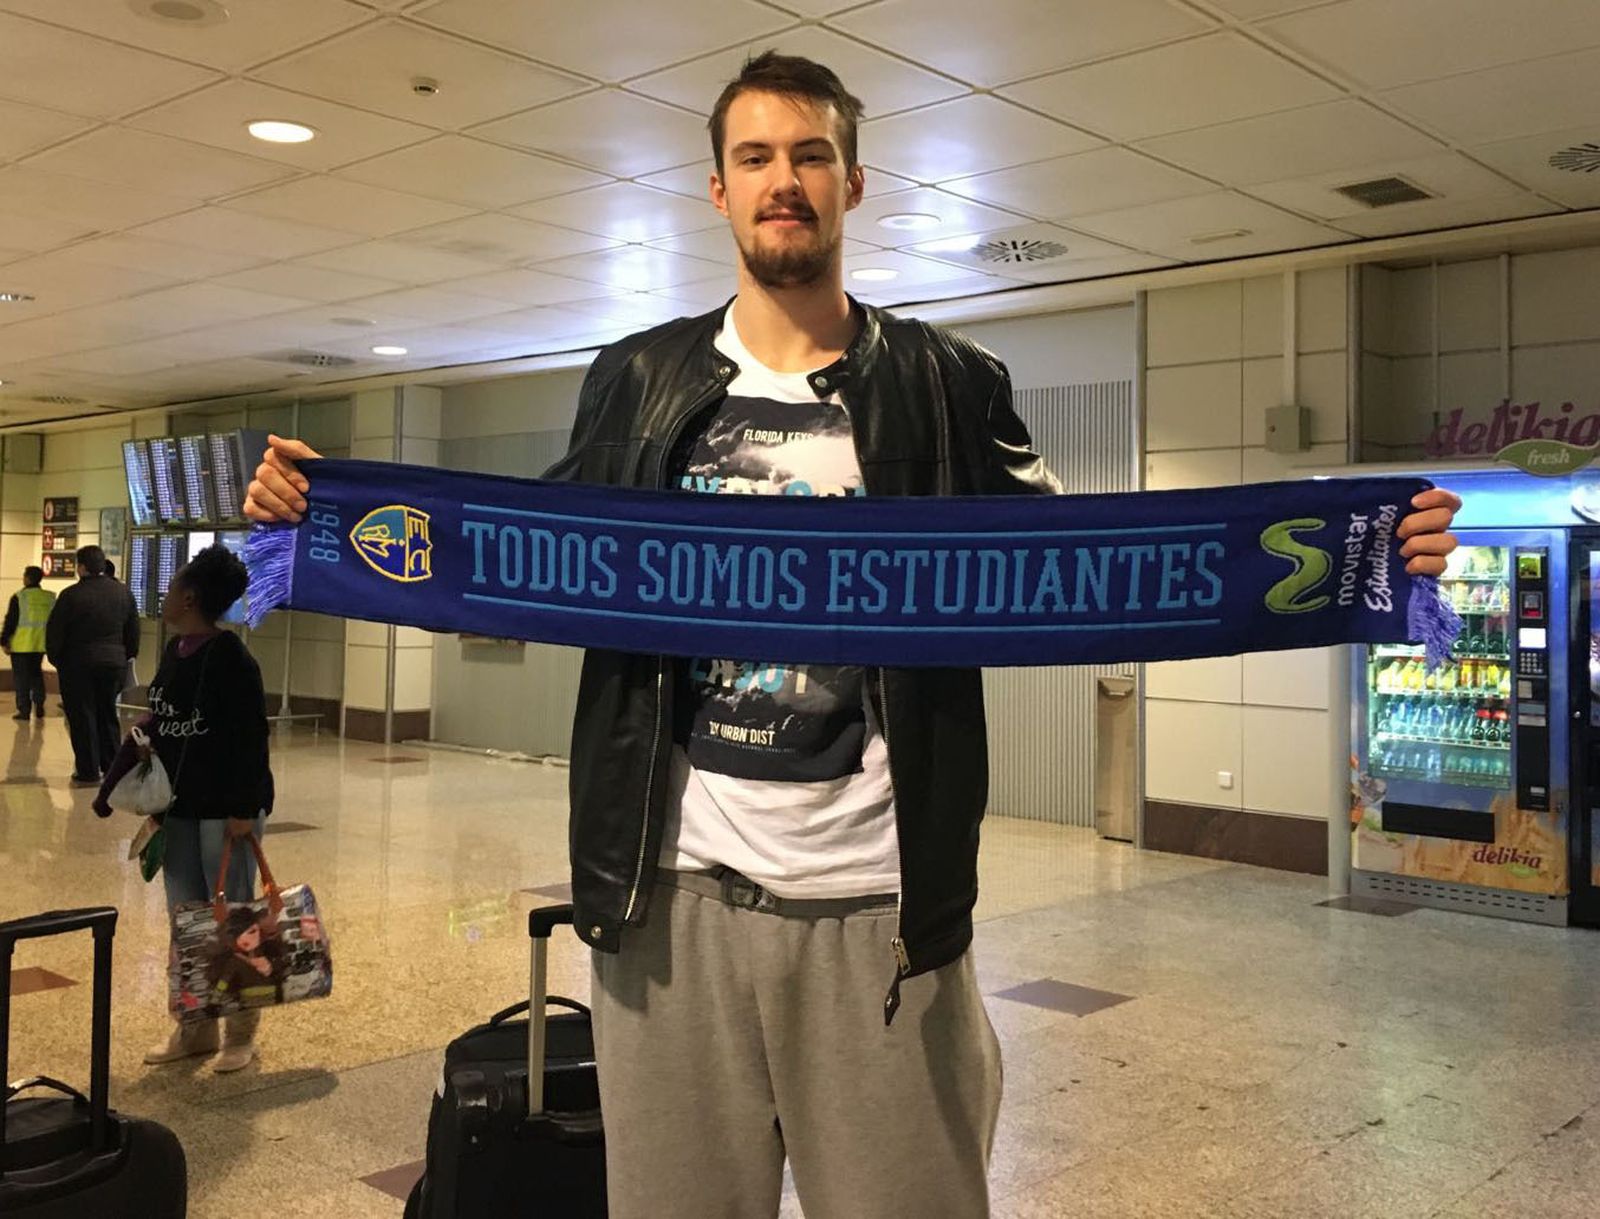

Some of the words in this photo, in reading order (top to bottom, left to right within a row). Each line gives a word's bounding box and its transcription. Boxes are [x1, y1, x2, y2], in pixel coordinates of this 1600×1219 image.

[743, 428, 784, 443] FLORIDA
[786, 431, 814, 444] KEYS
[1527, 449, 1570, 466] fresh
[309, 502, 341, 563] 1948
[461, 521, 619, 599] TODOS
[637, 539, 807, 612] SOMOS
[825, 541, 1226, 615] ESTUDIANTES
[1337, 512, 1369, 606] movistar
[1363, 503, 1399, 613] Estudiantes
[720, 723, 748, 743] URBN
[749, 728, 776, 746] DIST
[1473, 844, 1541, 869] delikia
